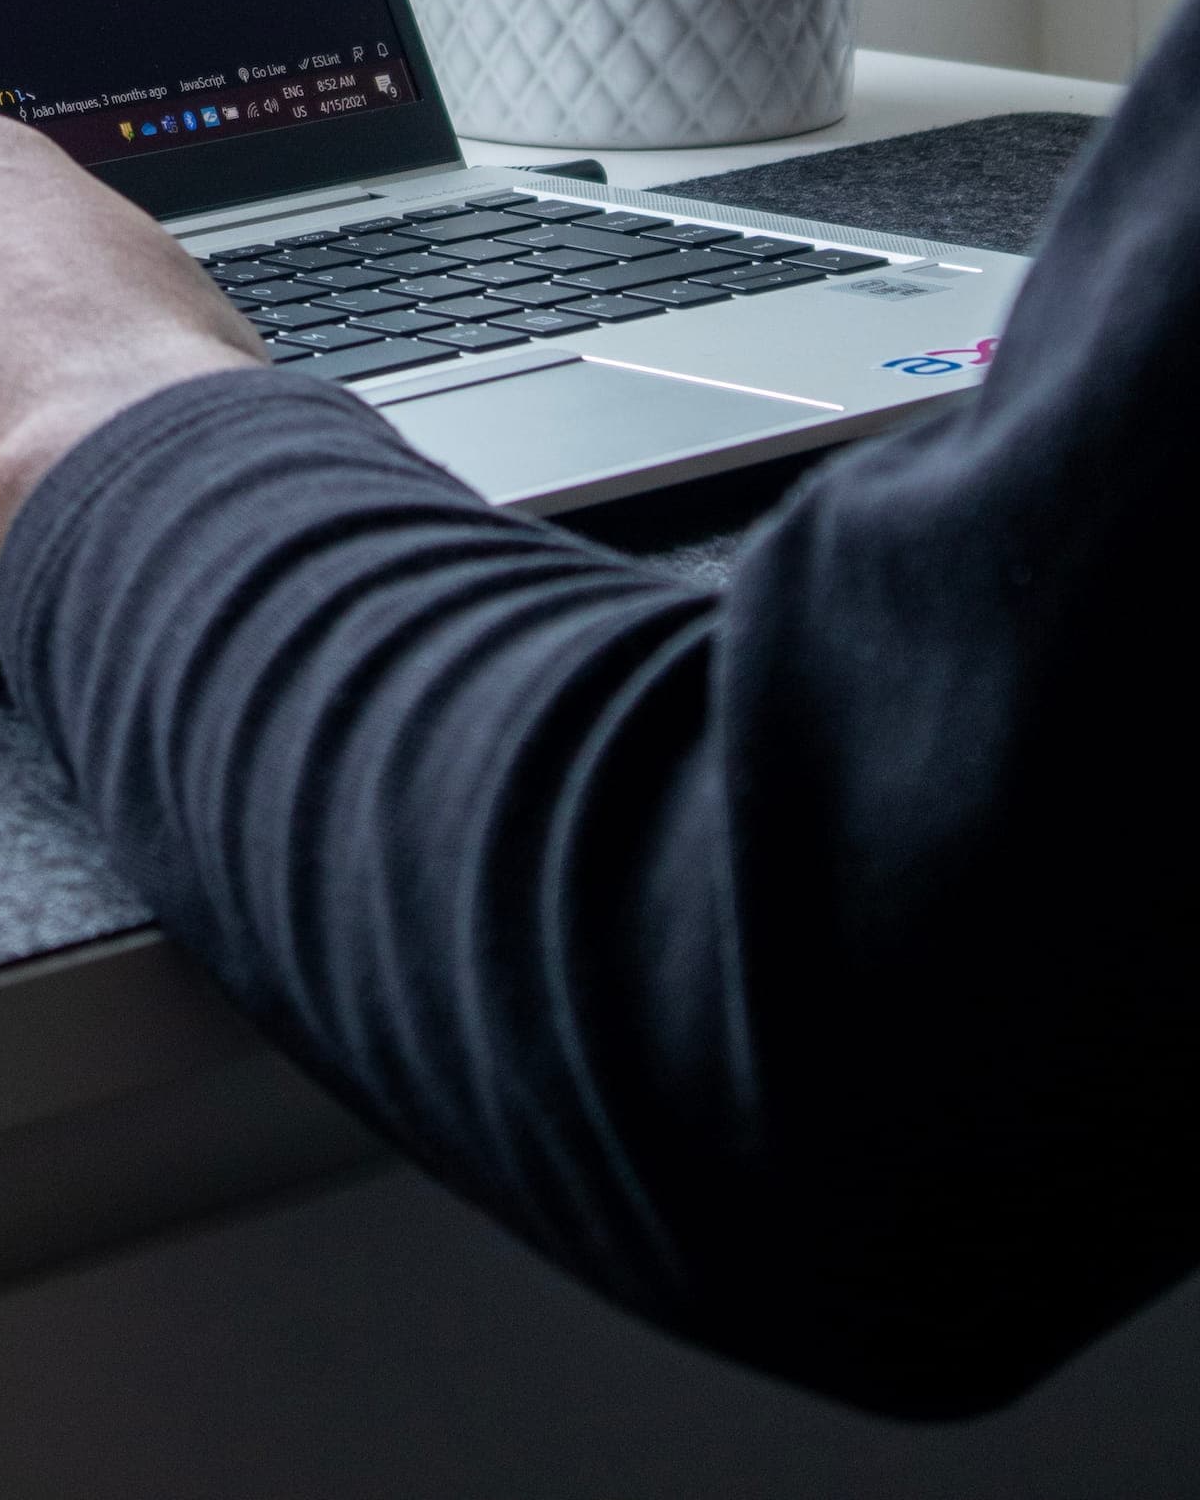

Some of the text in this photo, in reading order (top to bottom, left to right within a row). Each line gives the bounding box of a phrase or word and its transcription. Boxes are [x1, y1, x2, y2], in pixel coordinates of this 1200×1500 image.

[312, 53, 342, 68] ESLint
[251, 63, 287, 79] Go Live
[179, 74, 226, 93] JavaScript
[316, 74, 357, 93] 8:52 AM
[282, 85, 305, 100] ENG
[32, 85, 168, 120] João Marques, 3 months ago
[319, 94, 367, 115] 4/15/2021
[292, 105, 308, 120] US
